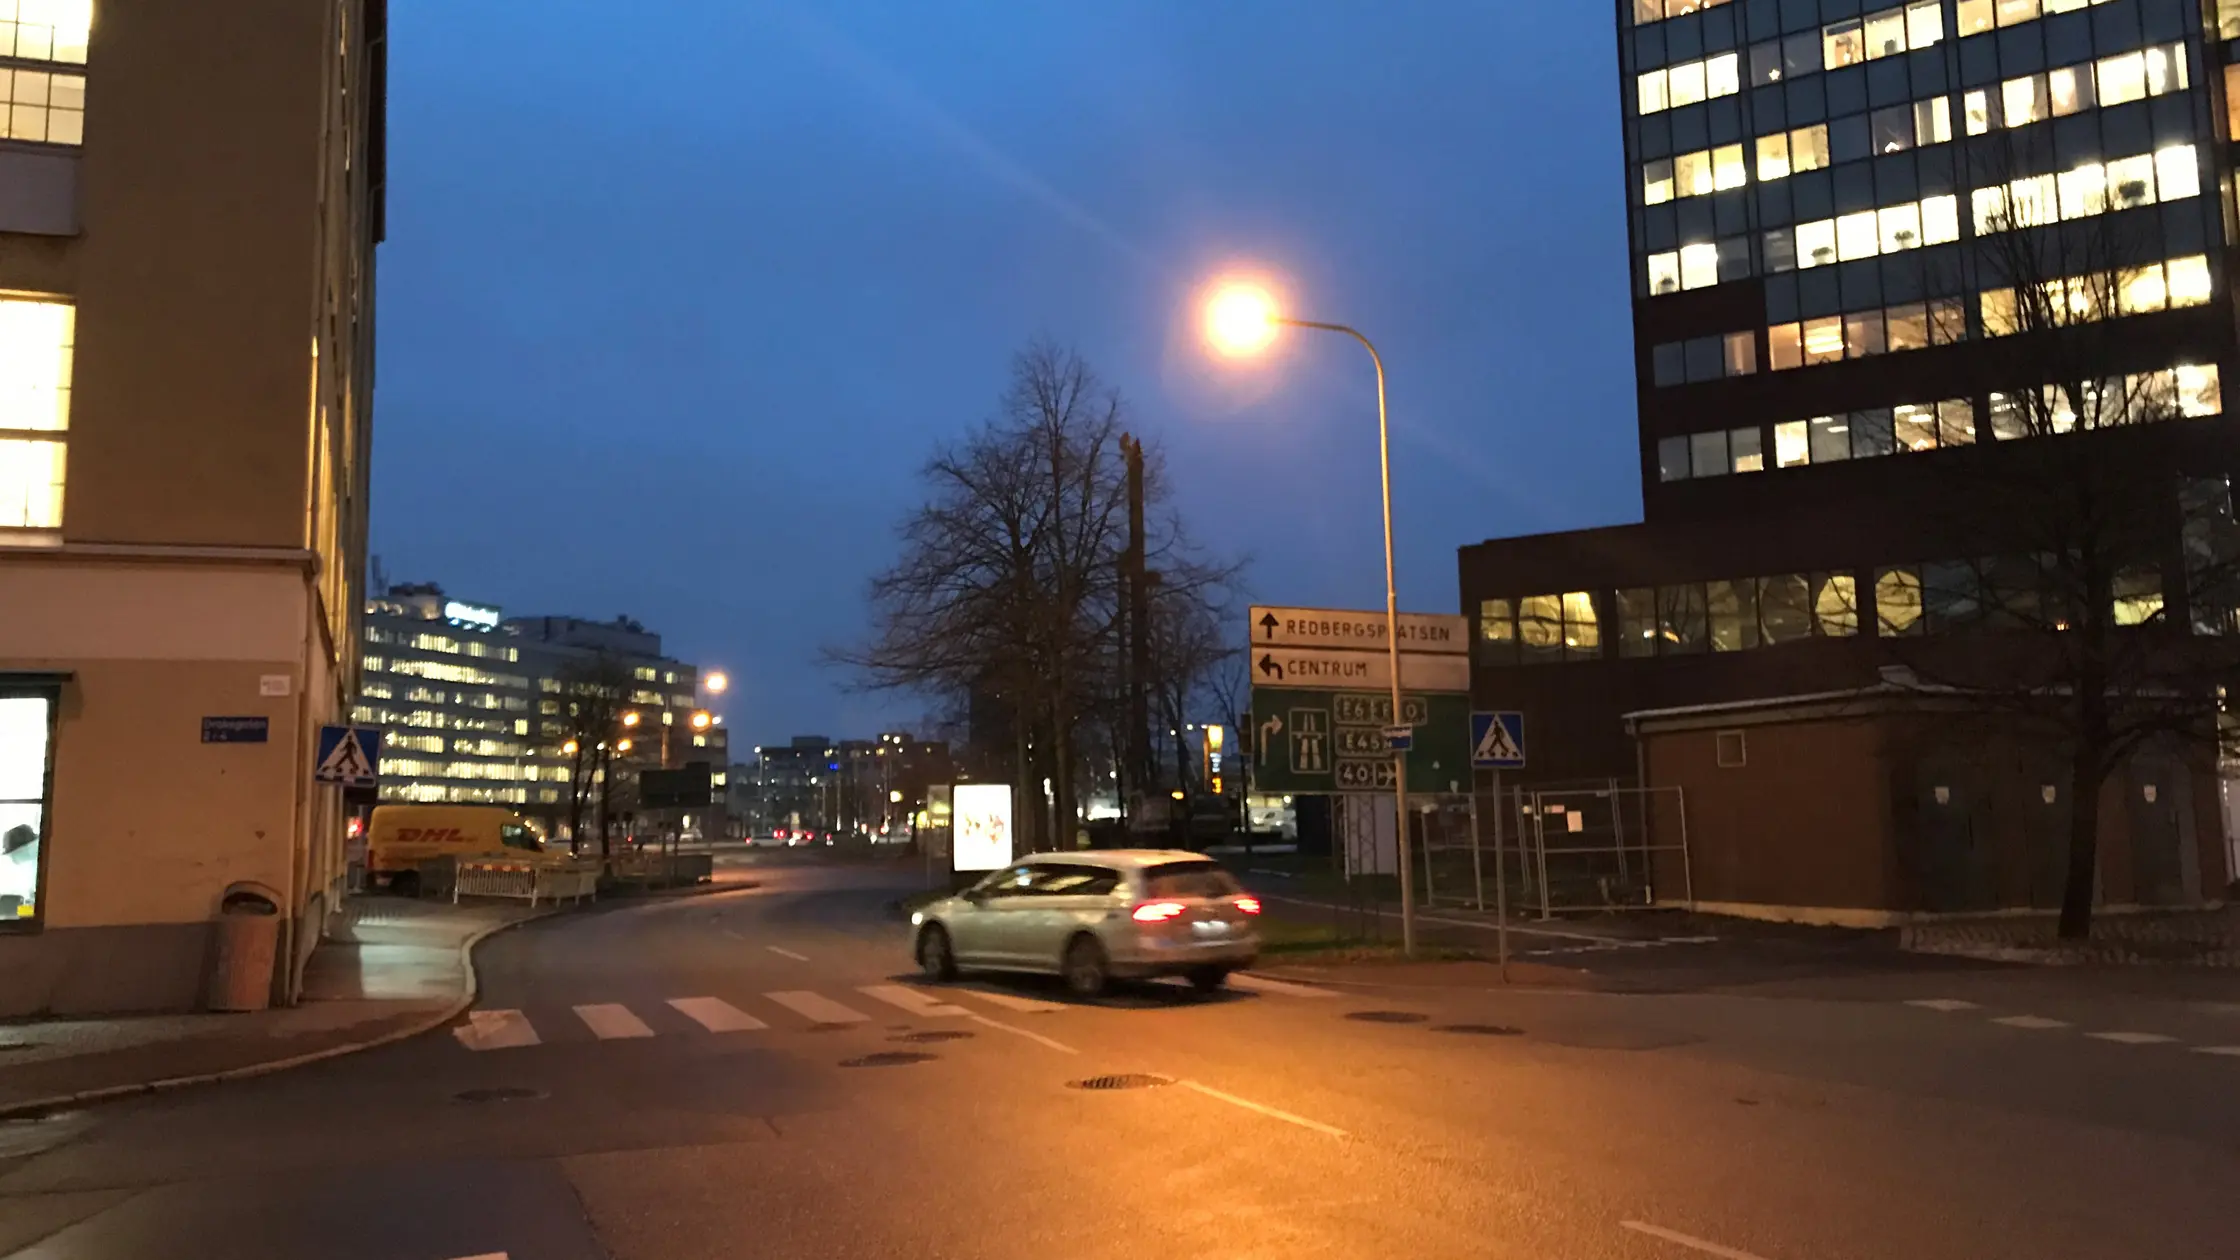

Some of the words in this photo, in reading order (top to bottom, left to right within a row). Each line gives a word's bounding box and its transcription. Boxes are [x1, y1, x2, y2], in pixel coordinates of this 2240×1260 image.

[1287, 620, 1450, 641] REDBERGSPATSEN
[1287, 660, 1368, 678] CENTRUM
[1343, 700, 1364, 717] E6
[1382, 702, 1418, 719] E0
[1346, 735, 1380, 750] E45
[1343, 767, 1367, 782] 40
[397, 828, 463, 842] DHL
